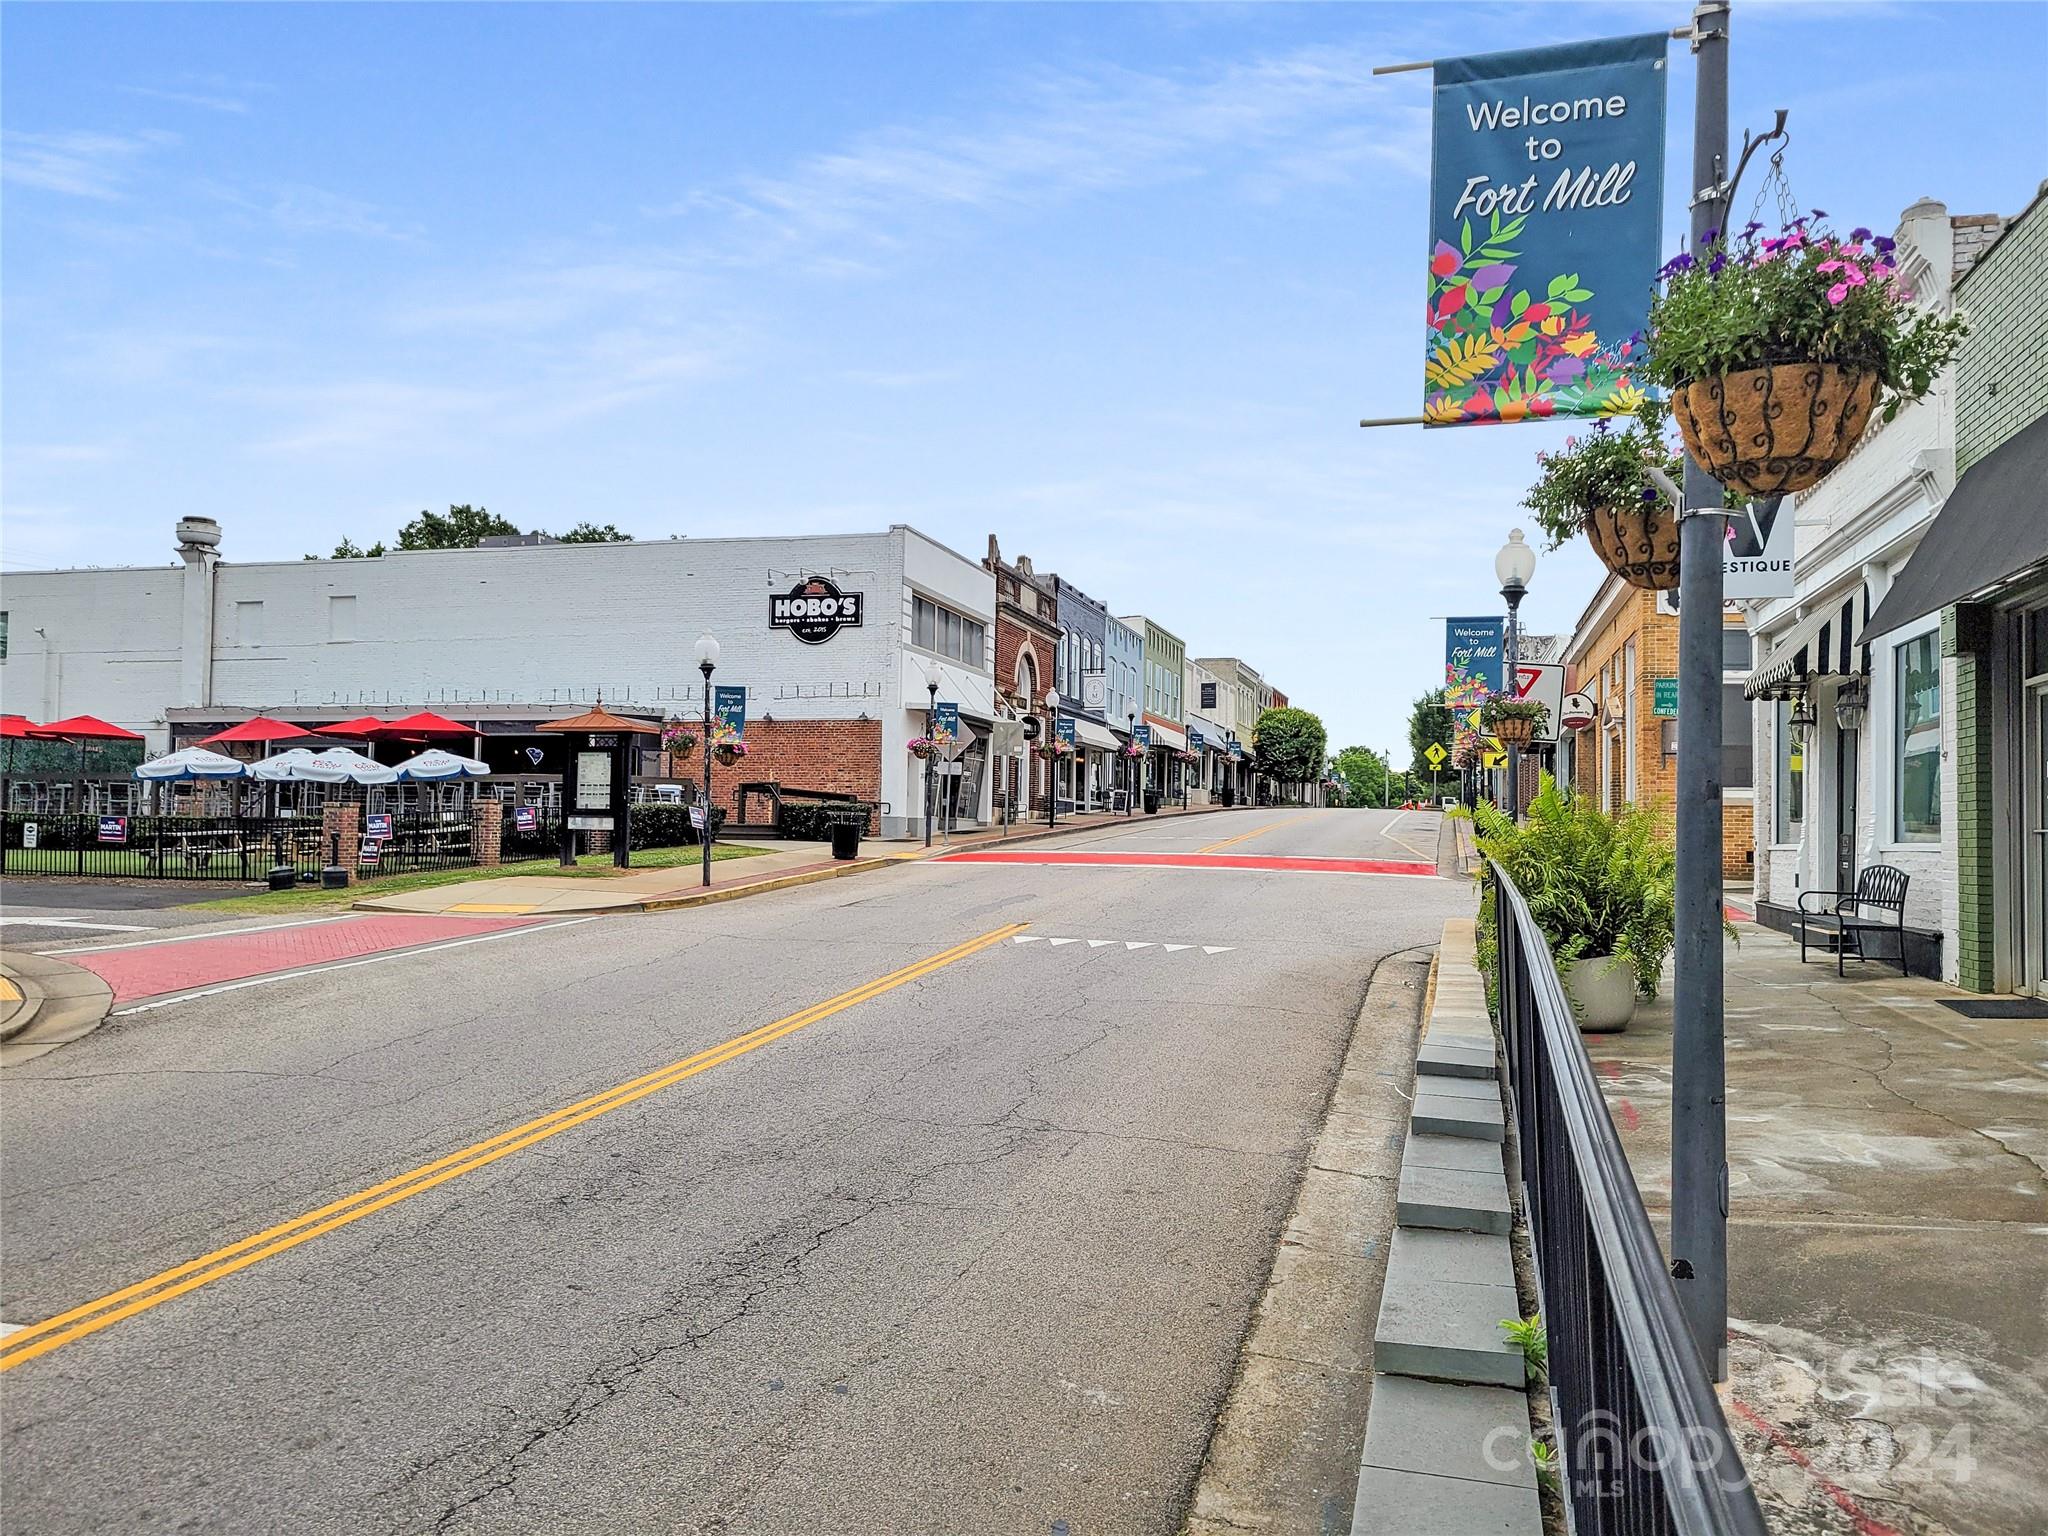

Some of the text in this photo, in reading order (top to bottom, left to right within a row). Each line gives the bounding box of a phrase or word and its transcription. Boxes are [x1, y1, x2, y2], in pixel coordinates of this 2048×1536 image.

[1466, 95, 1626, 131] Welcome
[1524, 136, 1562, 161] to
[1453, 160, 1637, 220] Fort Mill
[1722, 560, 1791, 573] ESTIQUE
[775, 597, 856, 617] HOBO'S
[1454, 628, 1495, 637] Welcome
[1469, 637, 1479, 645] to
[1451, 646, 1497, 658] Fort Mill
[717, 704, 743, 713] Fort Mill
